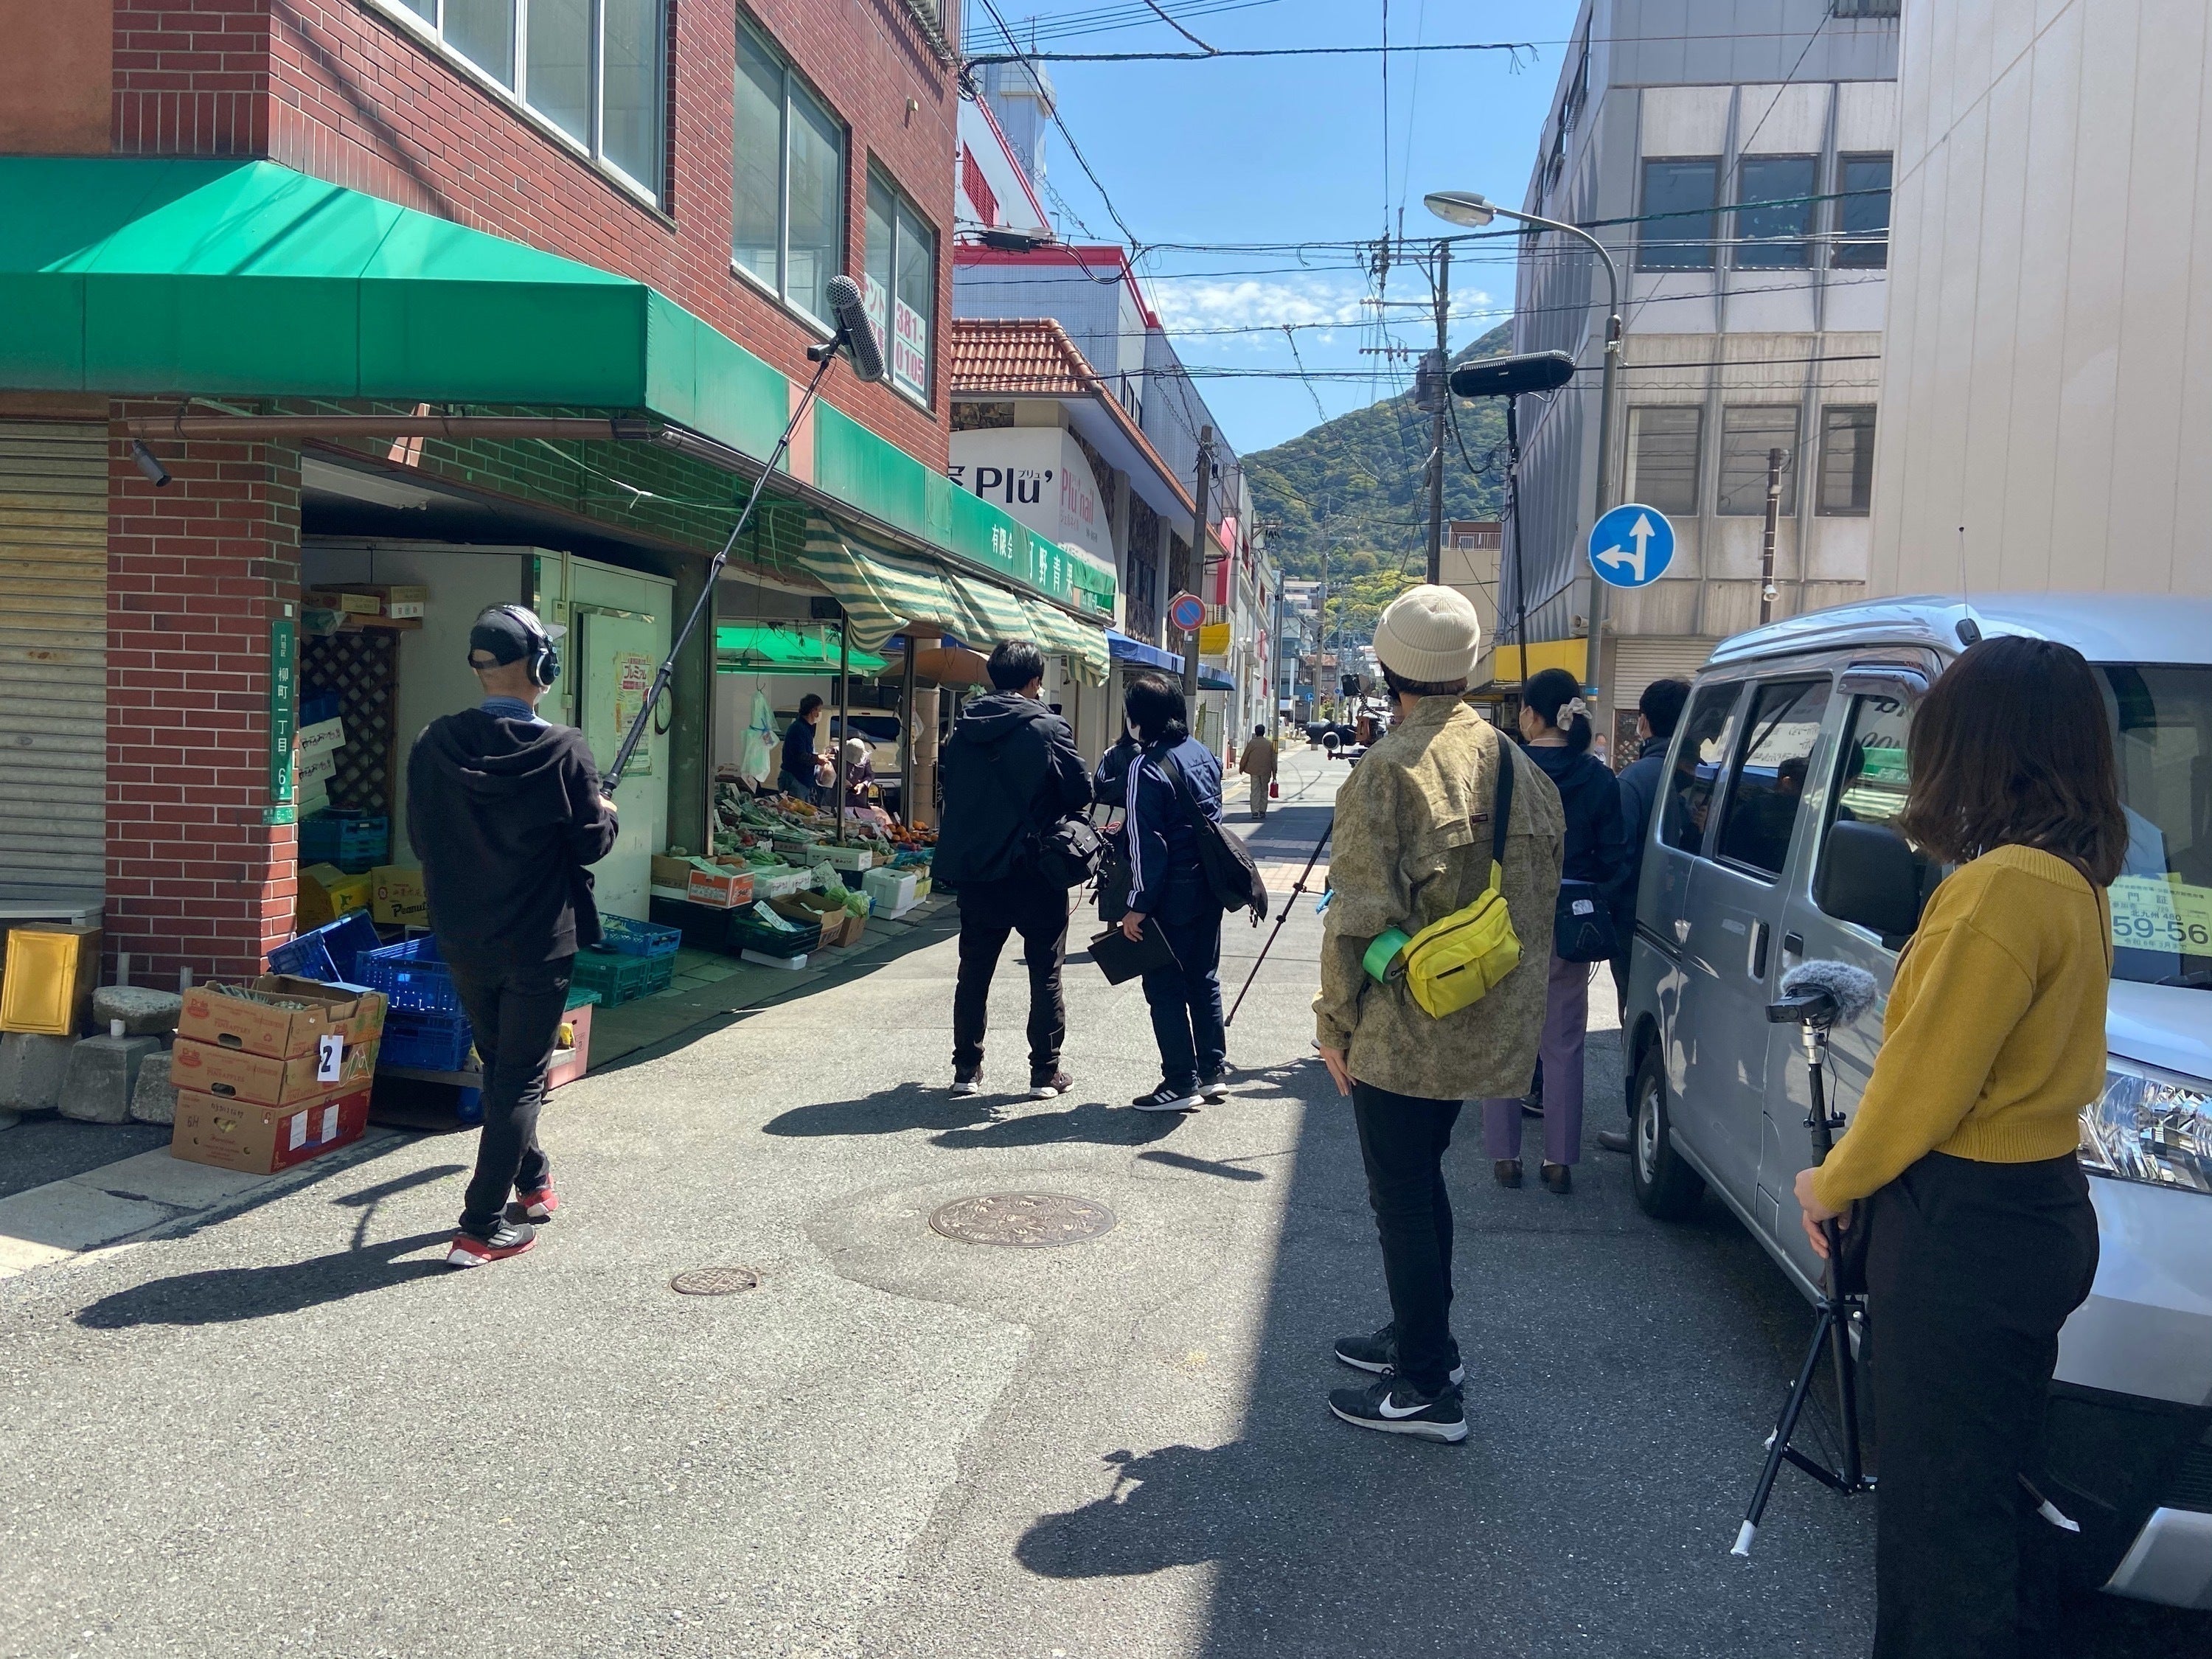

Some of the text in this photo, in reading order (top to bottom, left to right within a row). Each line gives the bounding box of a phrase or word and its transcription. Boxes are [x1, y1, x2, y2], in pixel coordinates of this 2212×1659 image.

[897, 302, 924, 344] 381-
[896, 341, 925, 386] 0105
[277, 667, 289, 752] 柳町一丁目
[2113, 915, 2209, 945] 59-56
[321, 1046, 333, 1073] 2
